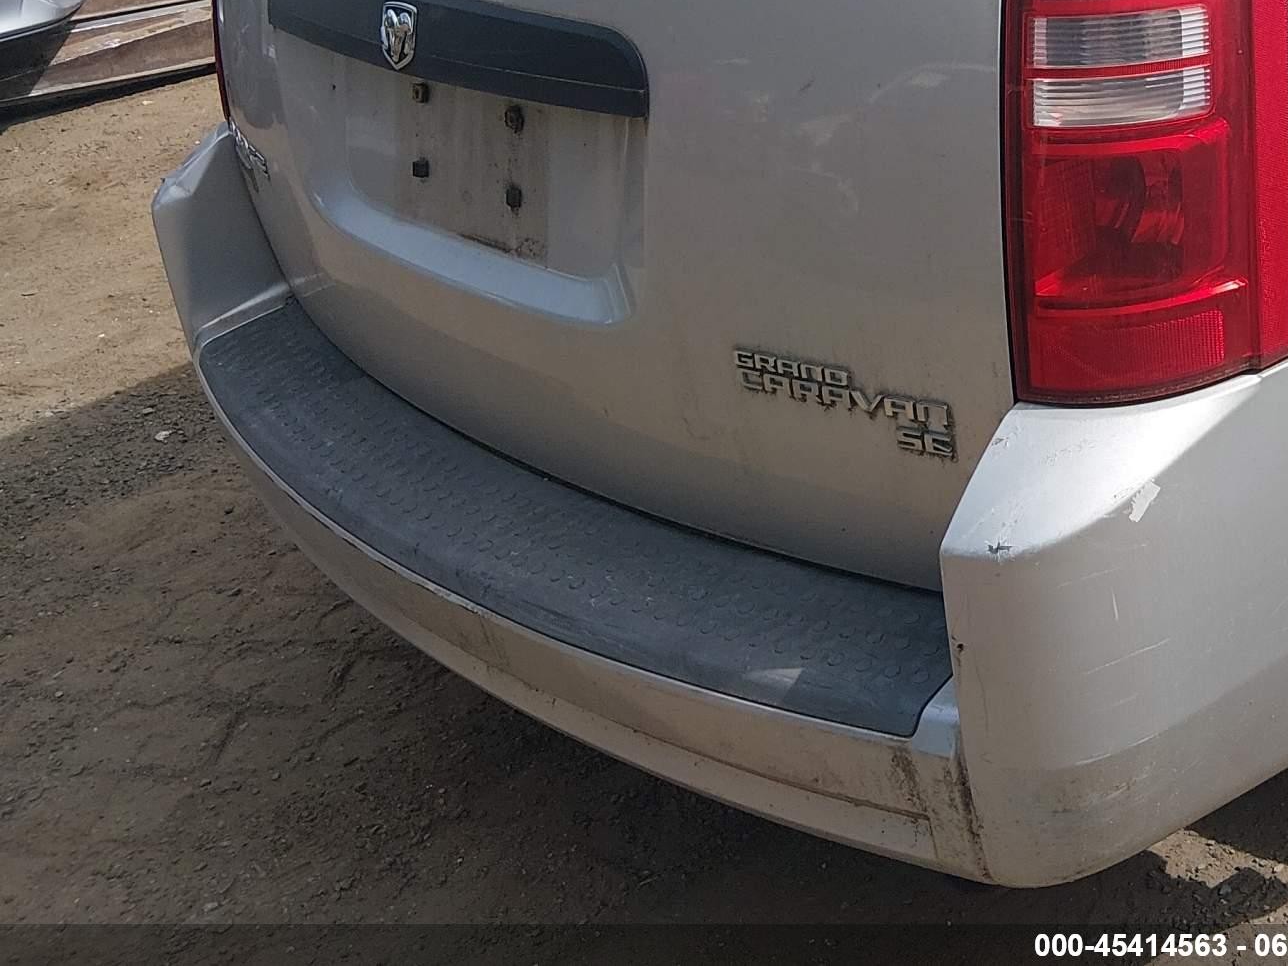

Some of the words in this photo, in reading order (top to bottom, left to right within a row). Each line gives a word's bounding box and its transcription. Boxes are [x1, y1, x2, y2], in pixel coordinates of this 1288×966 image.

[735, 350, 850, 386] GRAND
[738, 369, 949, 426] CARAVAN
[897, 428, 953, 455] SE
